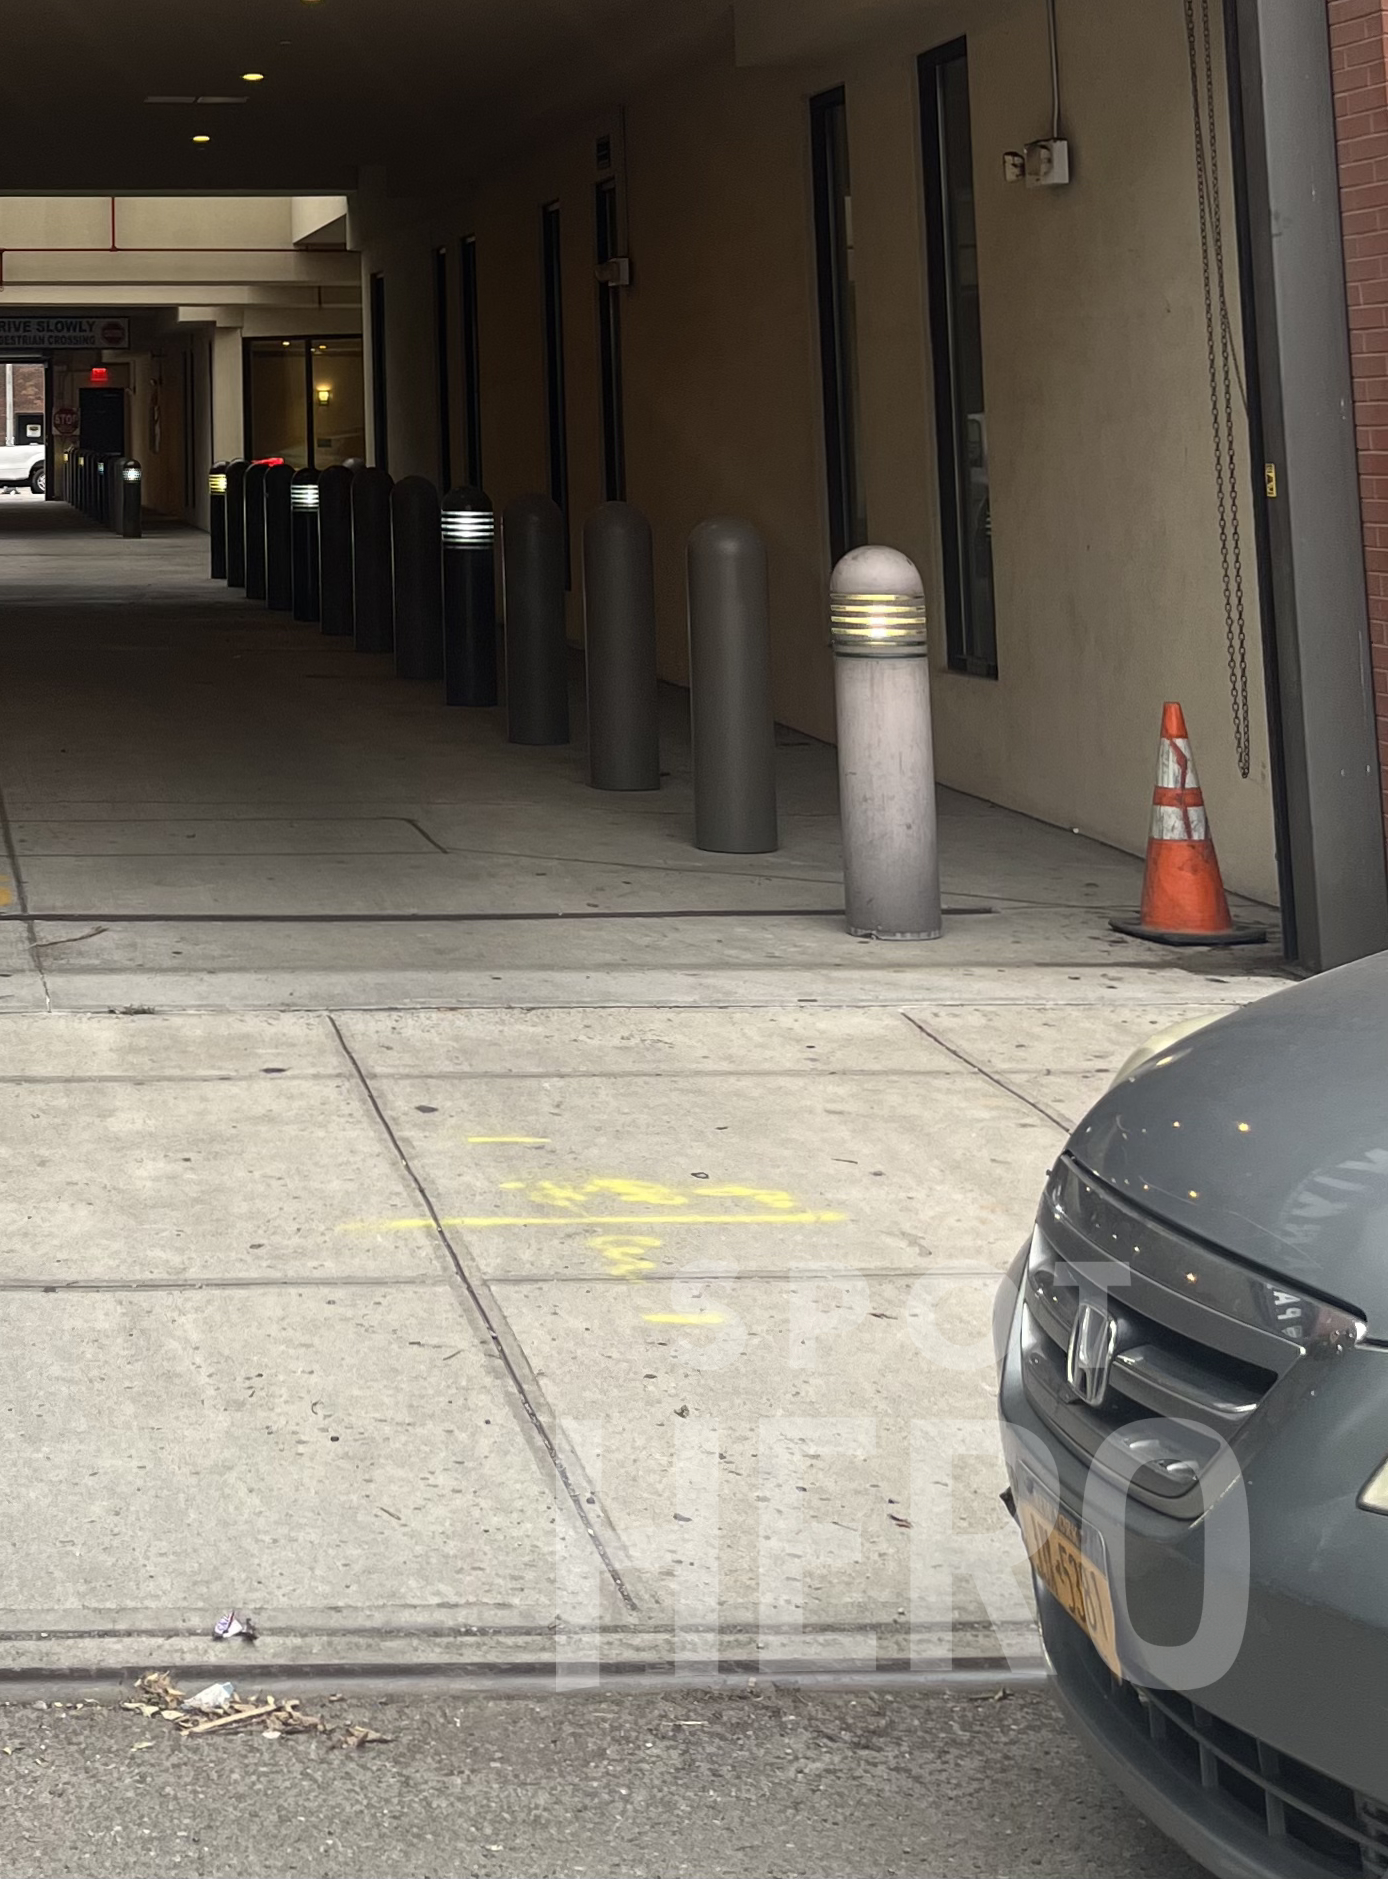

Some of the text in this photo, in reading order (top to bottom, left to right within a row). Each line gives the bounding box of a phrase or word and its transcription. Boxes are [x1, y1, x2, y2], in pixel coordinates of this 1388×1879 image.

[36, 320, 96, 333] SLOWLY
[46, 334, 96, 346] CROSSING
[55, 413, 78, 425] STOP
